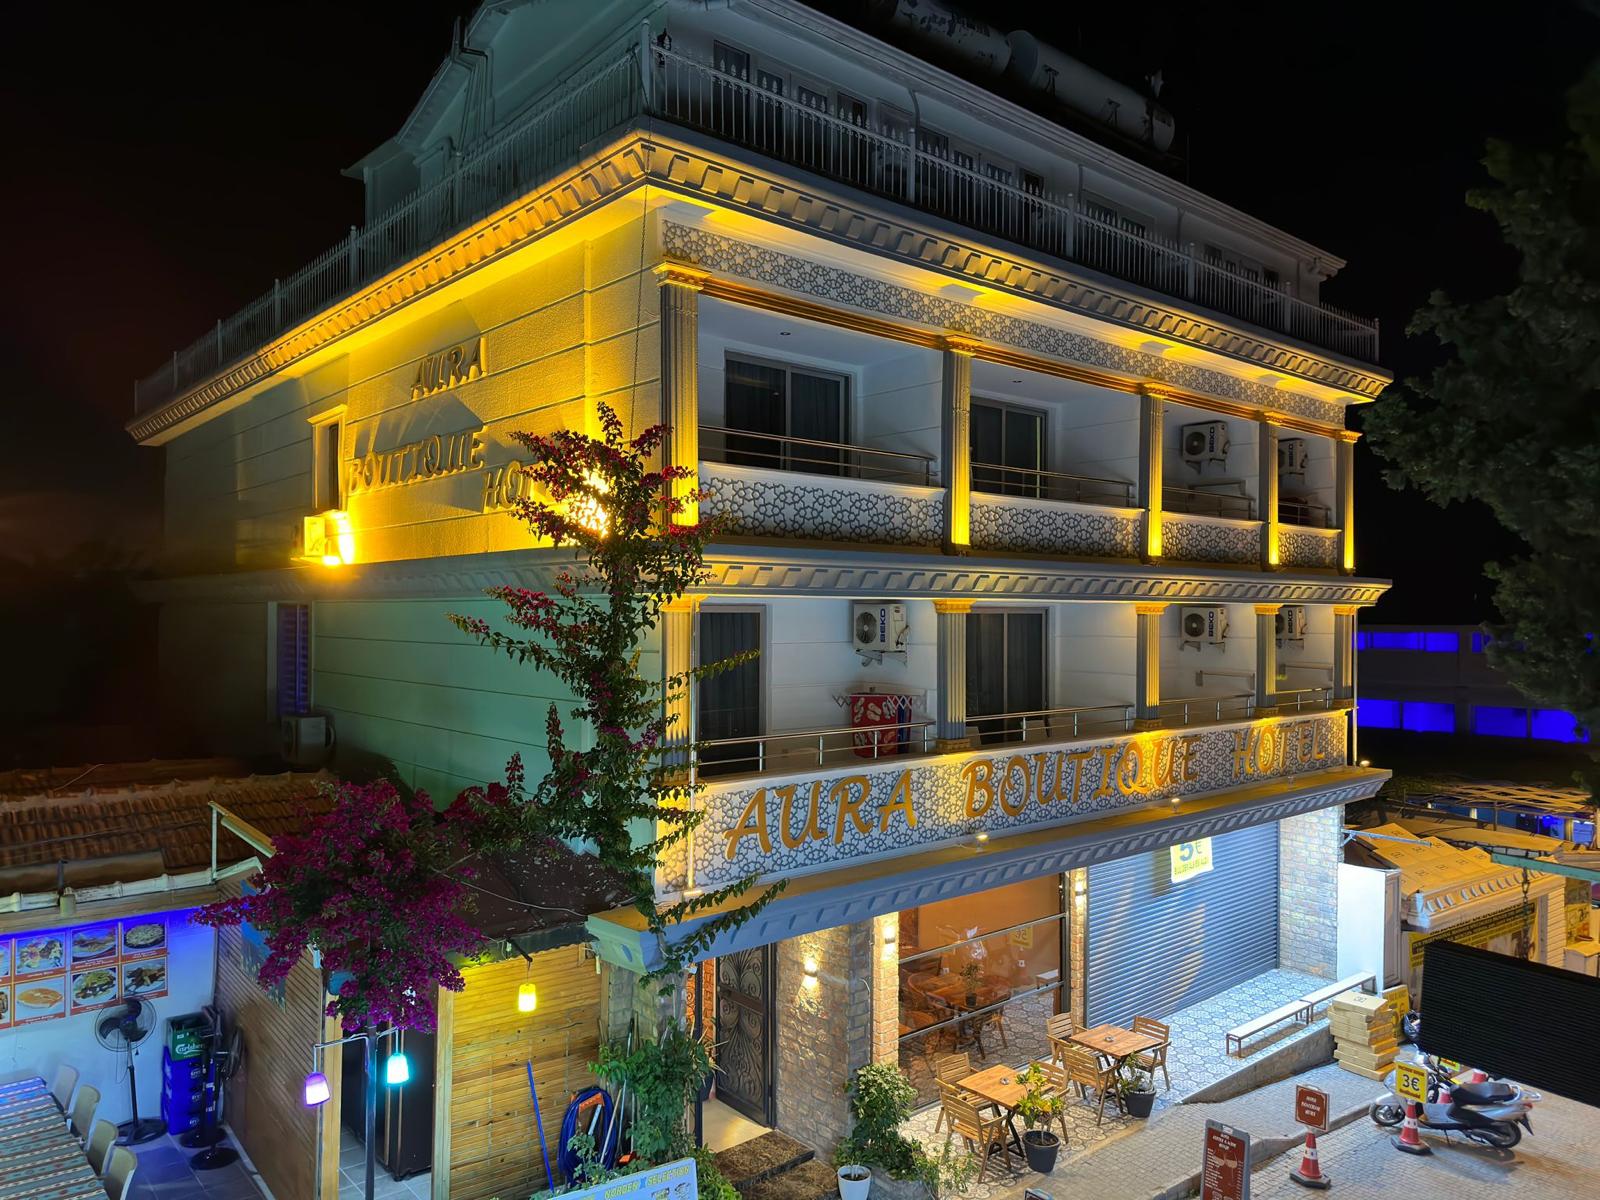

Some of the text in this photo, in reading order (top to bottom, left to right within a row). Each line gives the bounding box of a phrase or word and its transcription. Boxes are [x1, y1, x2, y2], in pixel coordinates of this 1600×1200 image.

[411, 337, 488, 401] AURA
[348, 429, 484, 493] BOUTIQUE
[724, 717, 1325, 860] AURA BOUTIQUE HOTEL
[1402, 1074, 1420, 1092] 3€
